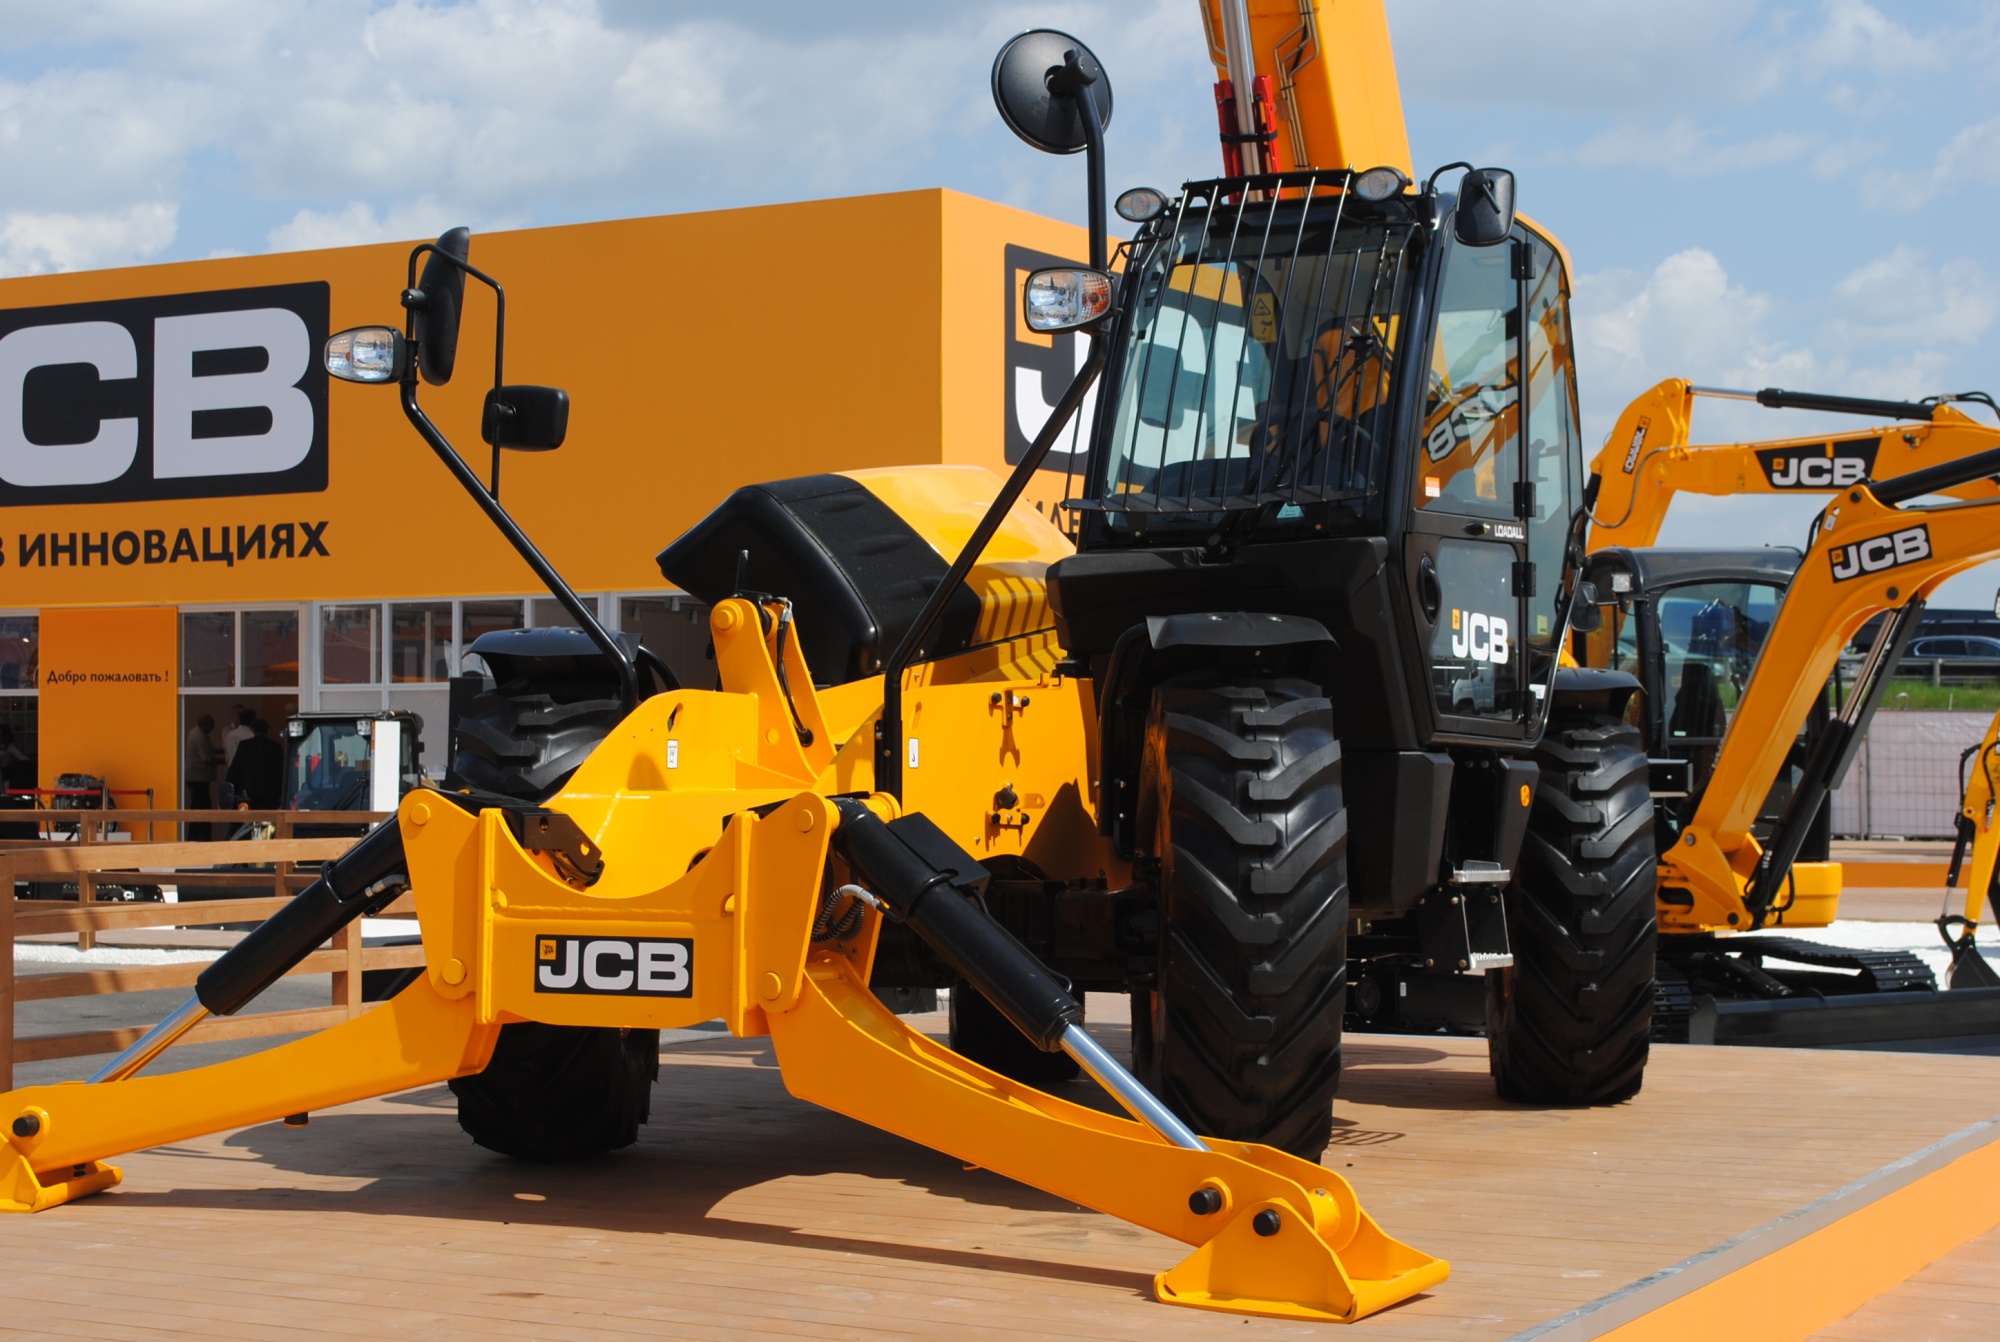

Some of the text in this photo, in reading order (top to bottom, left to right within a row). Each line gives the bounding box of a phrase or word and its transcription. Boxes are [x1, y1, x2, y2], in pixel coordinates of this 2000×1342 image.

[1771, 457, 1867, 487] JCB
[19, 521, 331, 568] ИННОВАЦИЯХ
[1494, 524, 1525, 540] LOADALL
[1832, 527, 1931, 580] JCB
[1452, 610, 1509, 665] JCB
[47, 670, 87, 686] Добро
[90, 673, 162, 683] пожаловать
[539, 940, 690, 992] JCB
